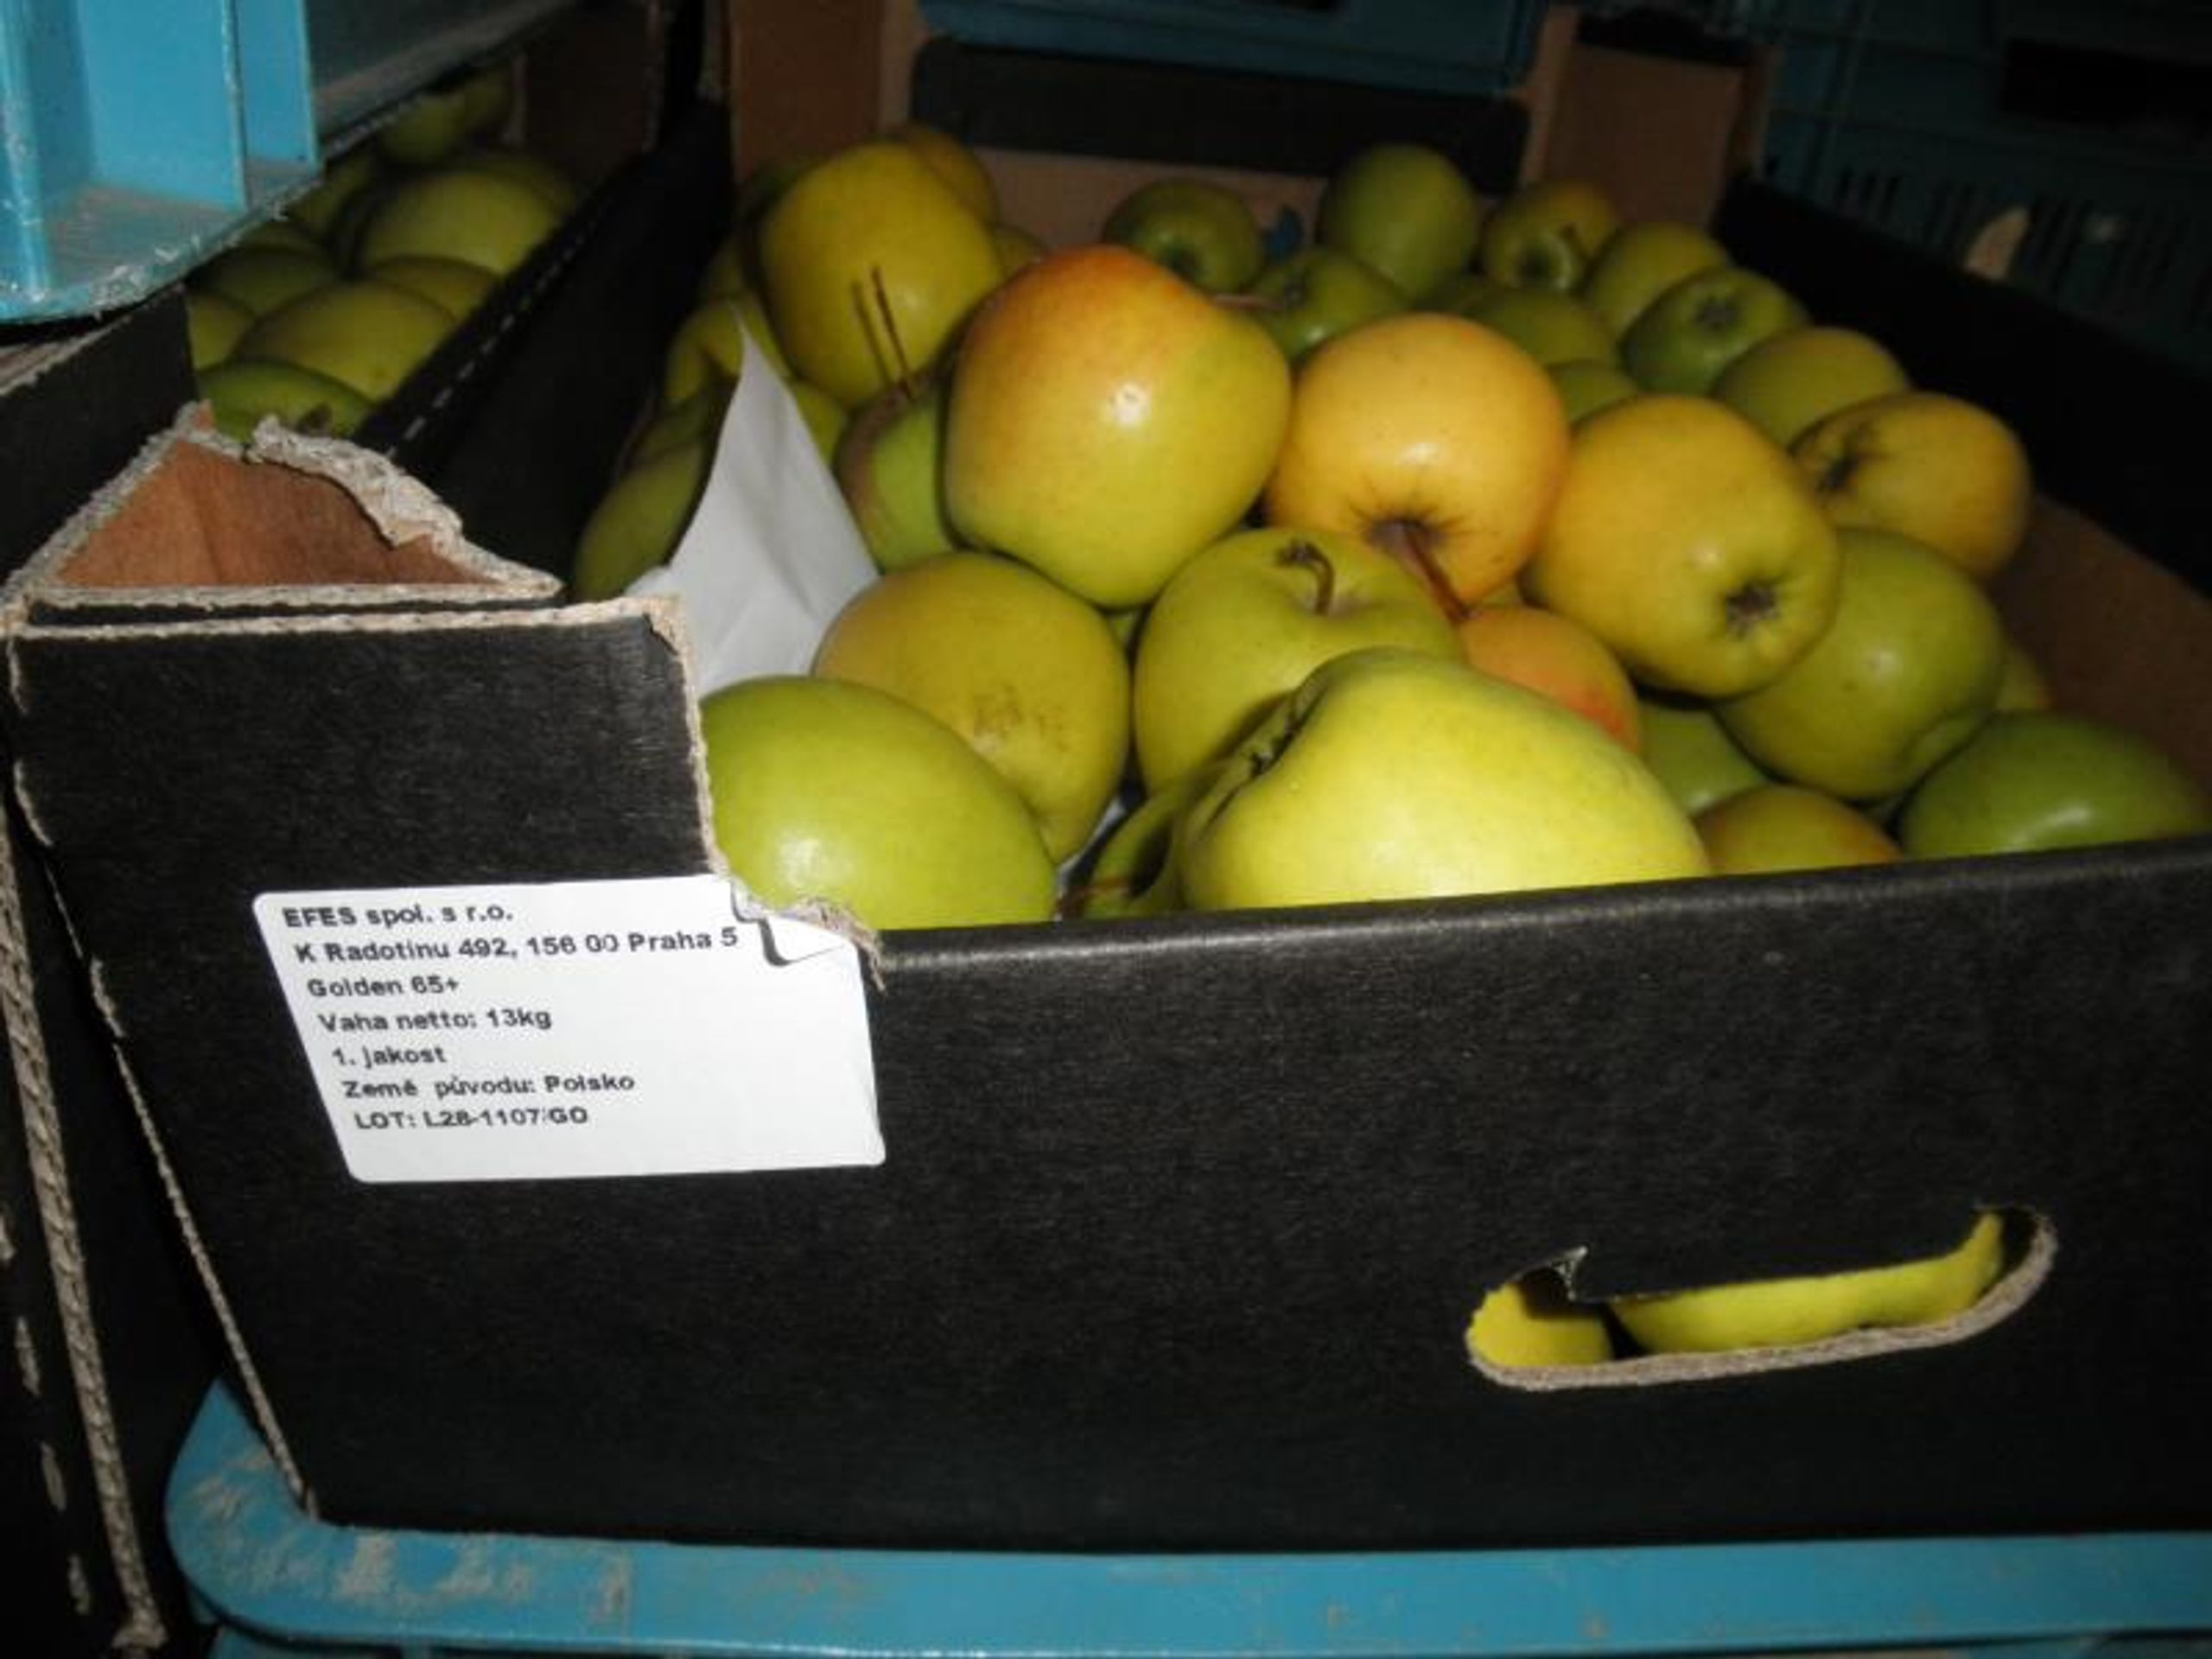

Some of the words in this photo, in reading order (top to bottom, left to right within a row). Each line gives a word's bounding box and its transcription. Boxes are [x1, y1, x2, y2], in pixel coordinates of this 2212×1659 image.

[282, 907, 357, 927] EFES
[365, 904, 433, 929] spol.
[442, 907, 457, 922] s
[466, 905, 512, 922] r.o.
[294, 943, 316, 963] K
[324, 940, 450, 963] Radotinu
[458, 938, 518, 958] 492,
[585, 934, 620, 952] 00
[627, 931, 712, 951] Praha
[721, 926, 738, 946] 5
[307, 977, 404, 997] Golden
[410, 975, 459, 995] 65+
[317, 1014, 389, 1032] Vaha
[396, 1011, 477, 1030] netto:
[486, 1007, 551, 1030] 13kg
[333, 1048, 355, 1065] 1.
[362, 1046, 447, 1069] jakost
[341, 1079, 417, 1098] Země
[435, 1075, 536, 1100] původu:
[543, 1073, 635, 1093] Polsko
[354, 1111, 416, 1129] LOT:
